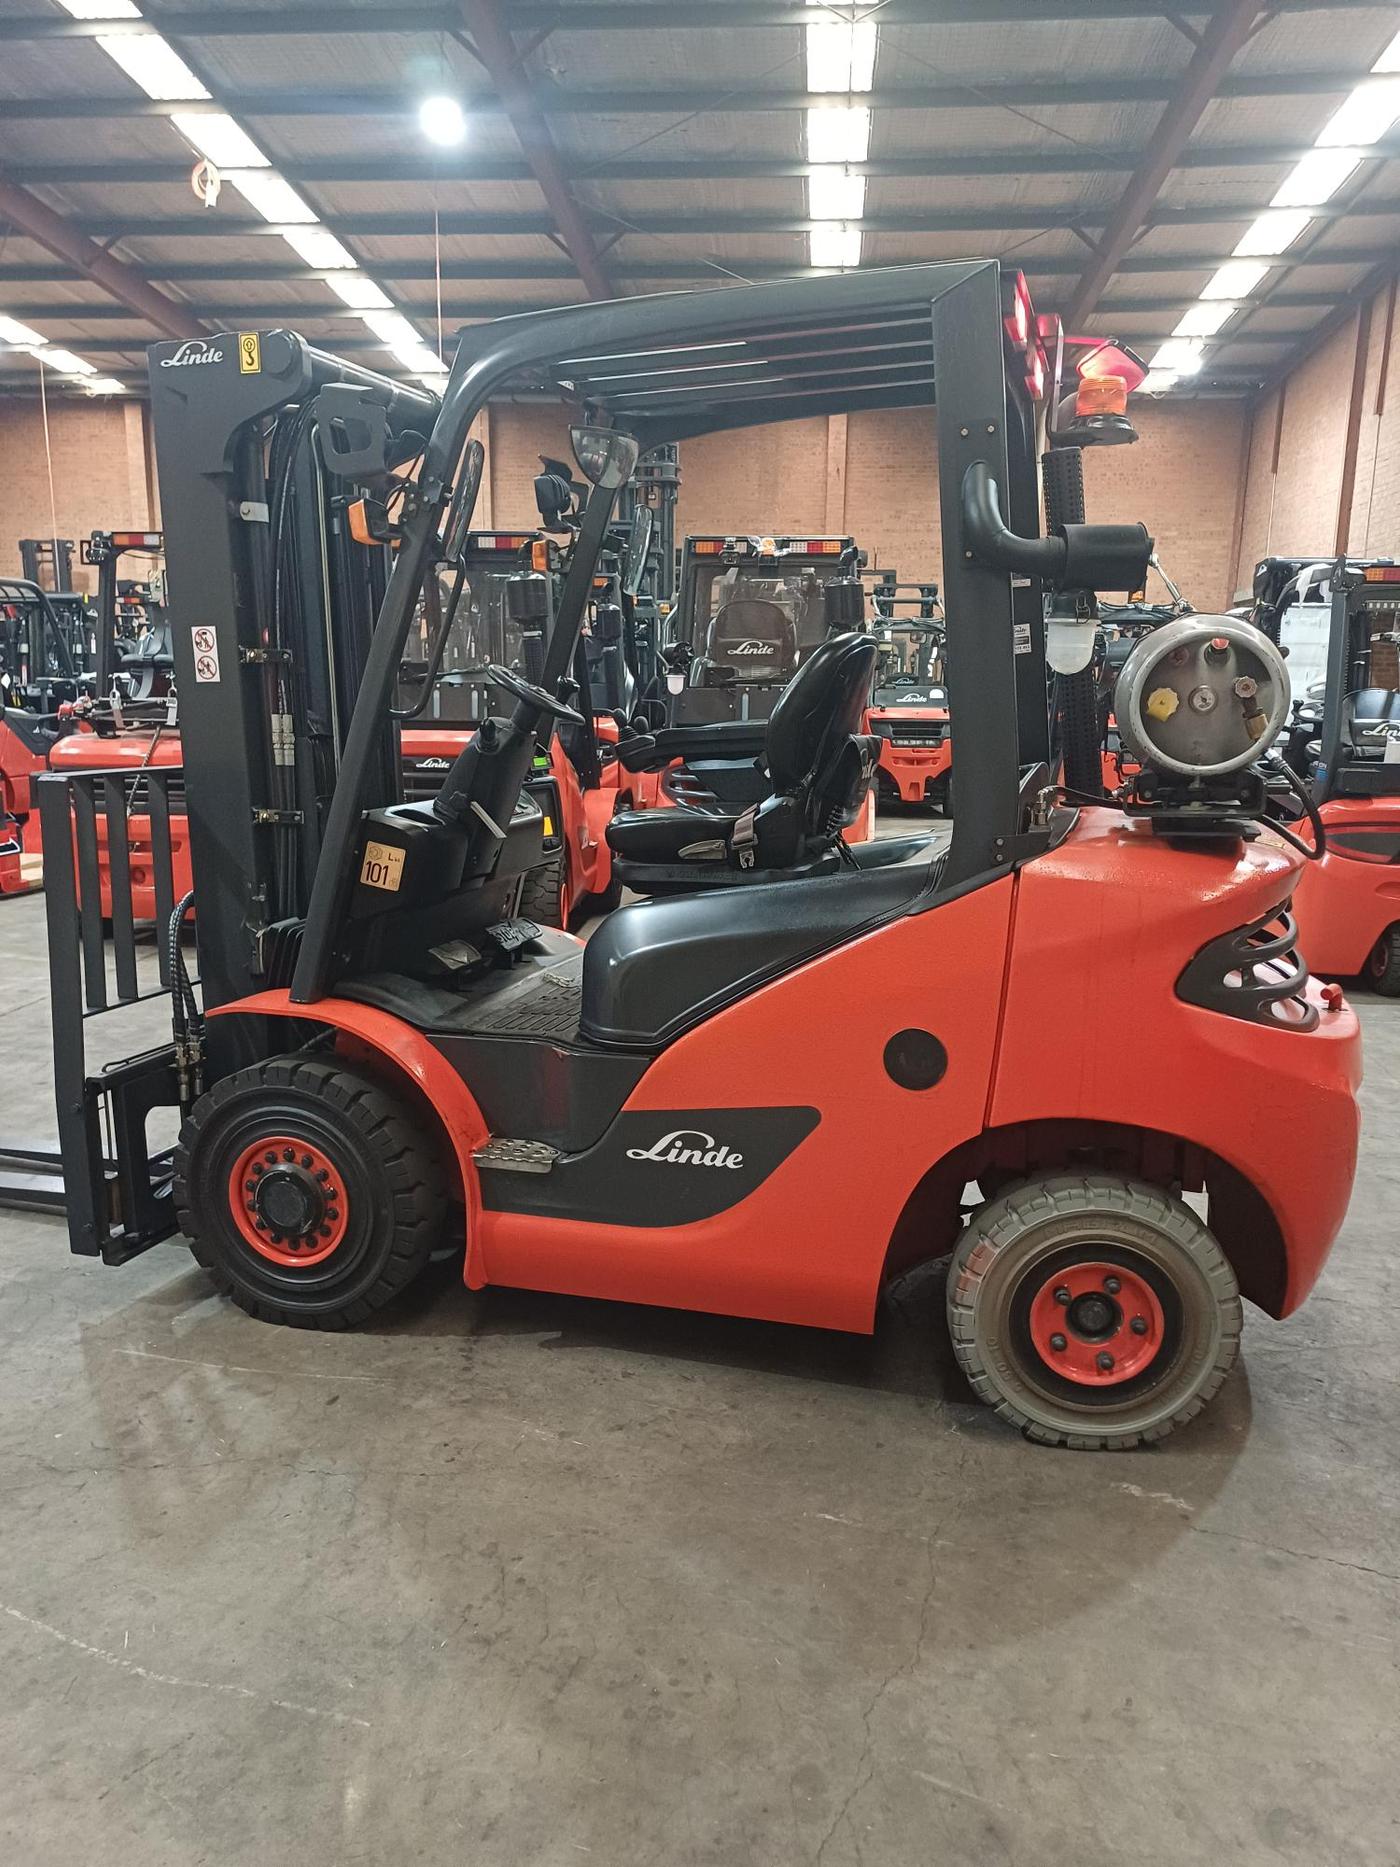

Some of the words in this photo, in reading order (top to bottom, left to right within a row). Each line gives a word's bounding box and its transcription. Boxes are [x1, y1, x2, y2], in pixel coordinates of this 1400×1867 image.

[160, 341, 223, 368] Linde
[727, 640, 774, 655] Linde
[896, 693, 928, 703] Linde
[416, 757, 450, 769] Linde
[365, 860, 389, 886] 101
[626, 1130, 744, 1169] Linde
